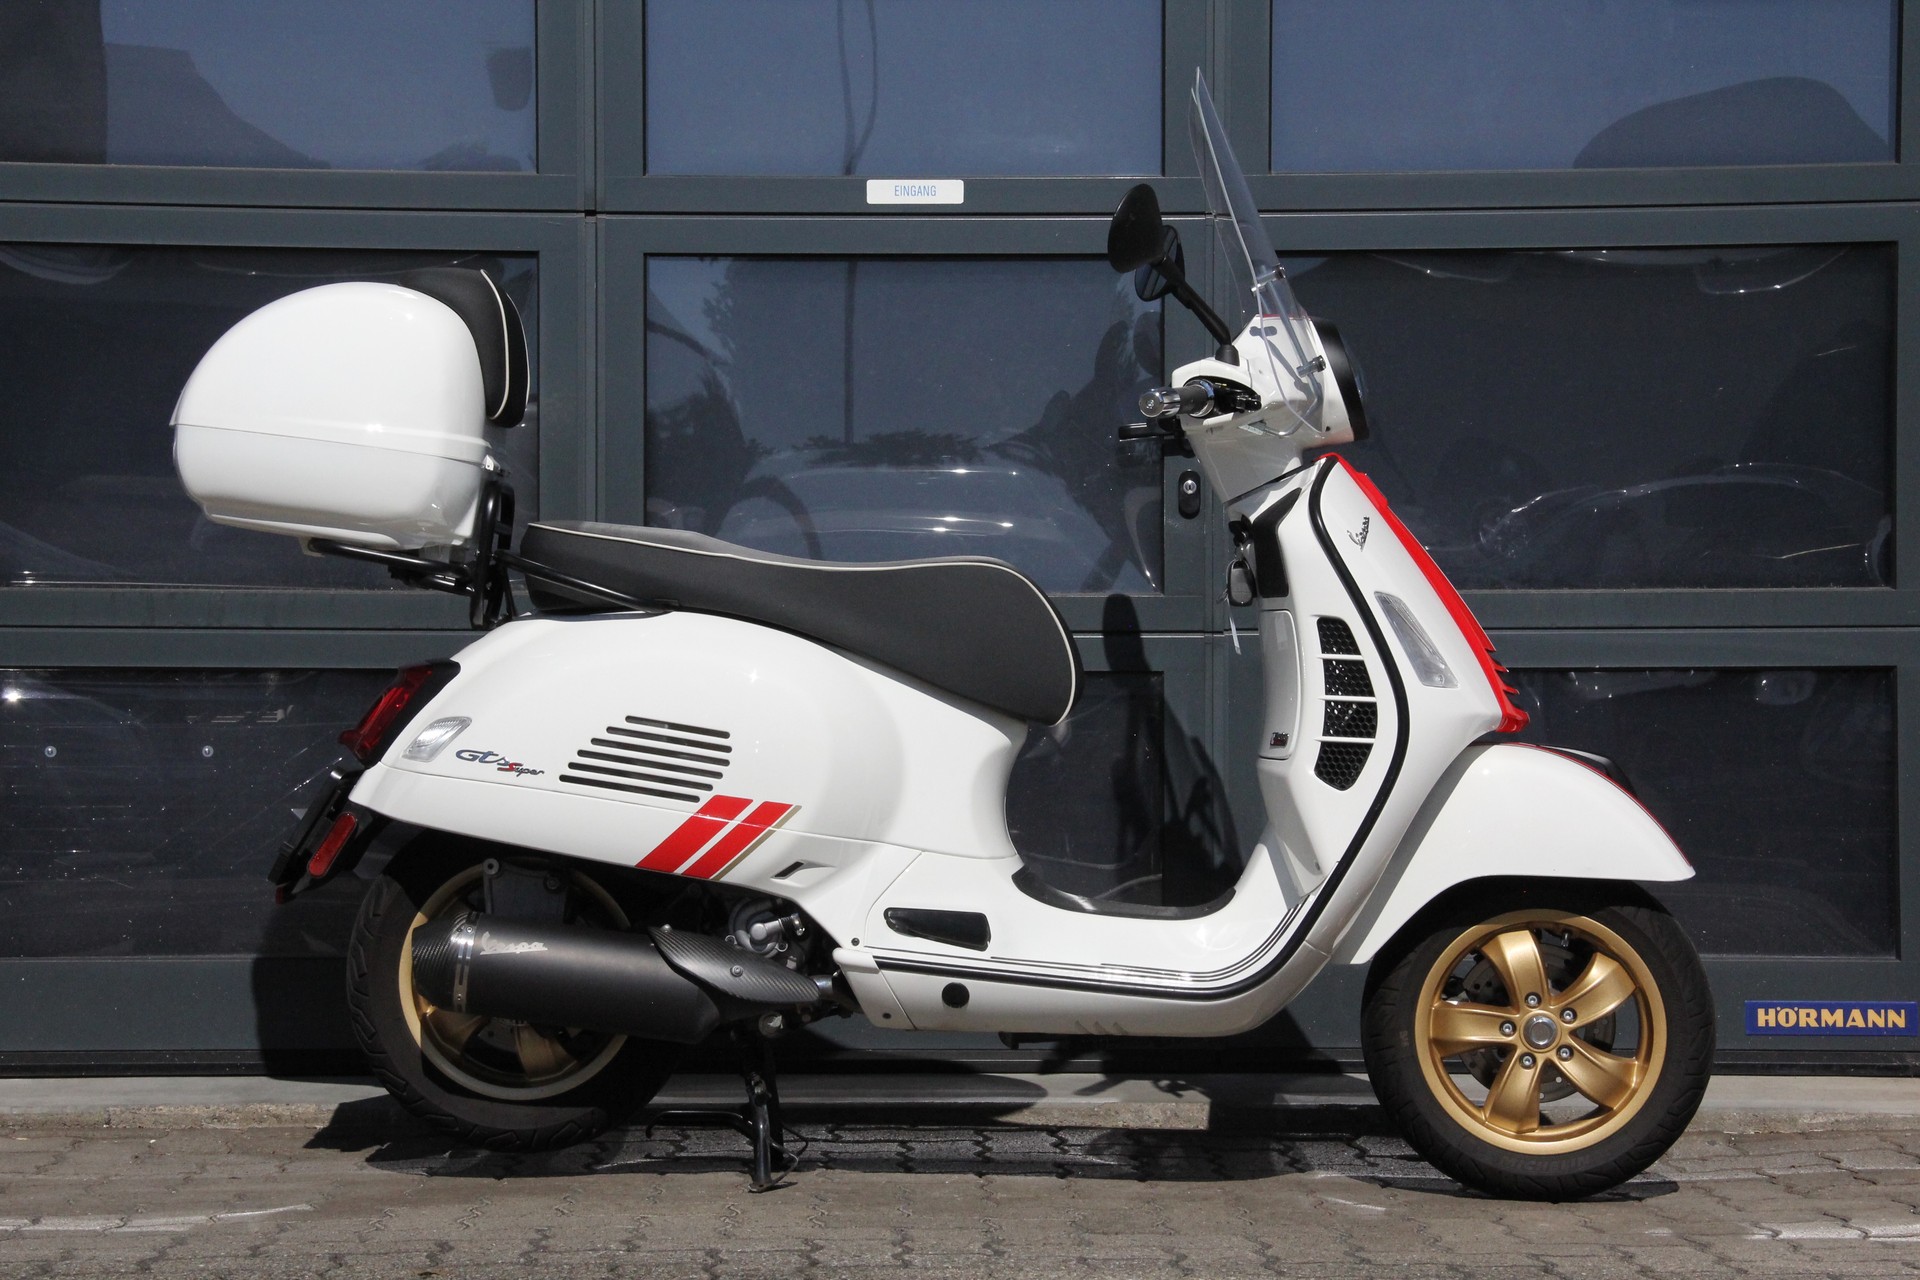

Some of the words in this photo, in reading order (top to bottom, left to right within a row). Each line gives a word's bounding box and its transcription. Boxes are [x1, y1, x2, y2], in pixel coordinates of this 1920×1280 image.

[894, 185, 937, 197] EINGANG
[497, 763, 545, 777] Super
[480, 931, 548, 955] Vespa
[1757, 1006, 1906, 1028] HÖRMANN
